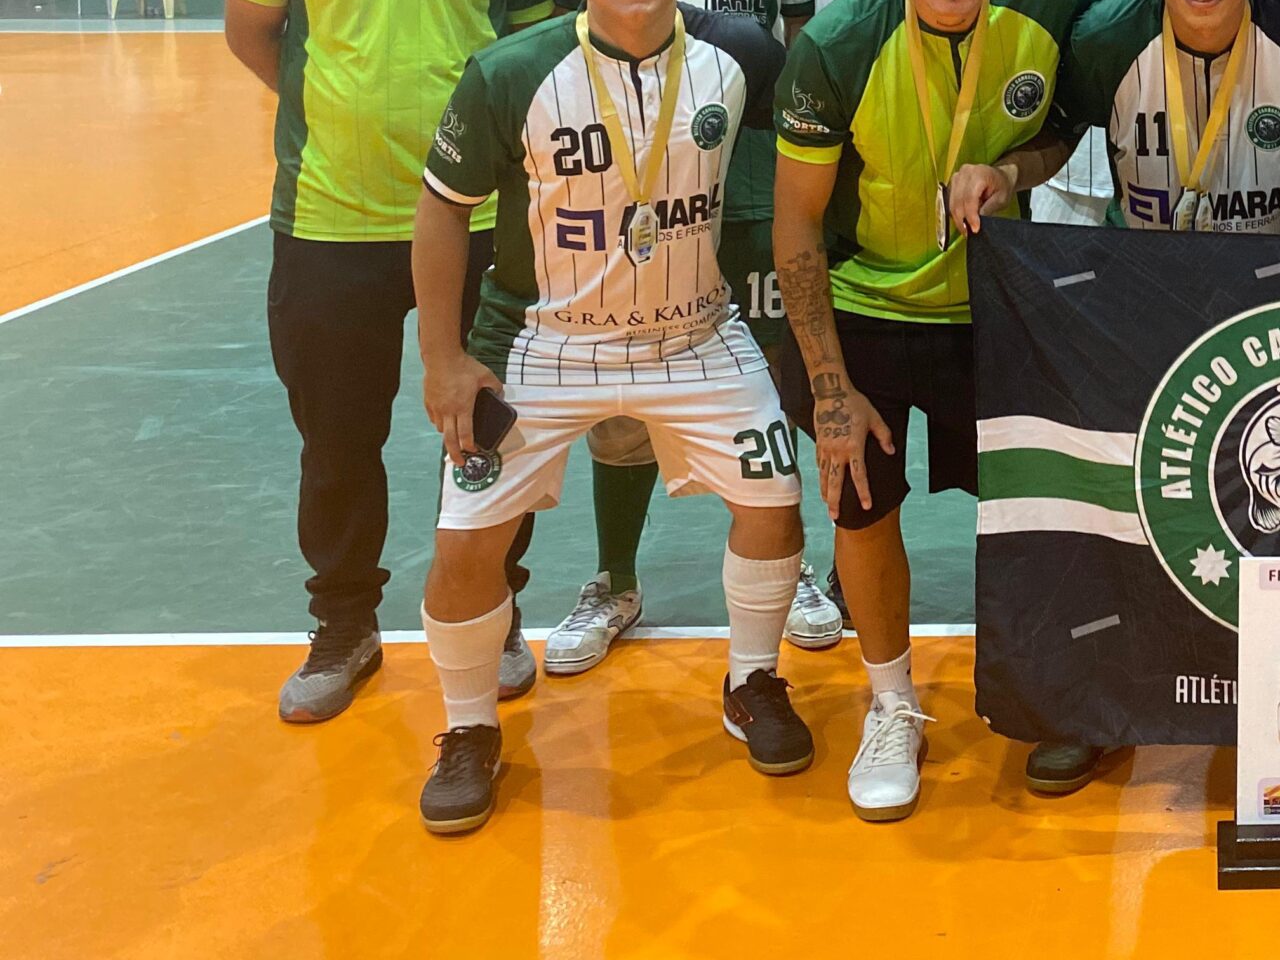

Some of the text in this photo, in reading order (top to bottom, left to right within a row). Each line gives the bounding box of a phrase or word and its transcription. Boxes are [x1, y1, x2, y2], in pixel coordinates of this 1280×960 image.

[551, 123, 612, 177] 20
[1135, 111, 1169, 157] 11
[676, 230, 682, 239] E
[627, 310, 645, 325] &
[747, 271, 787, 318] 16
[733, 420, 797, 479] 20
[1160, 355, 1239, 500] ATLÉTICO
